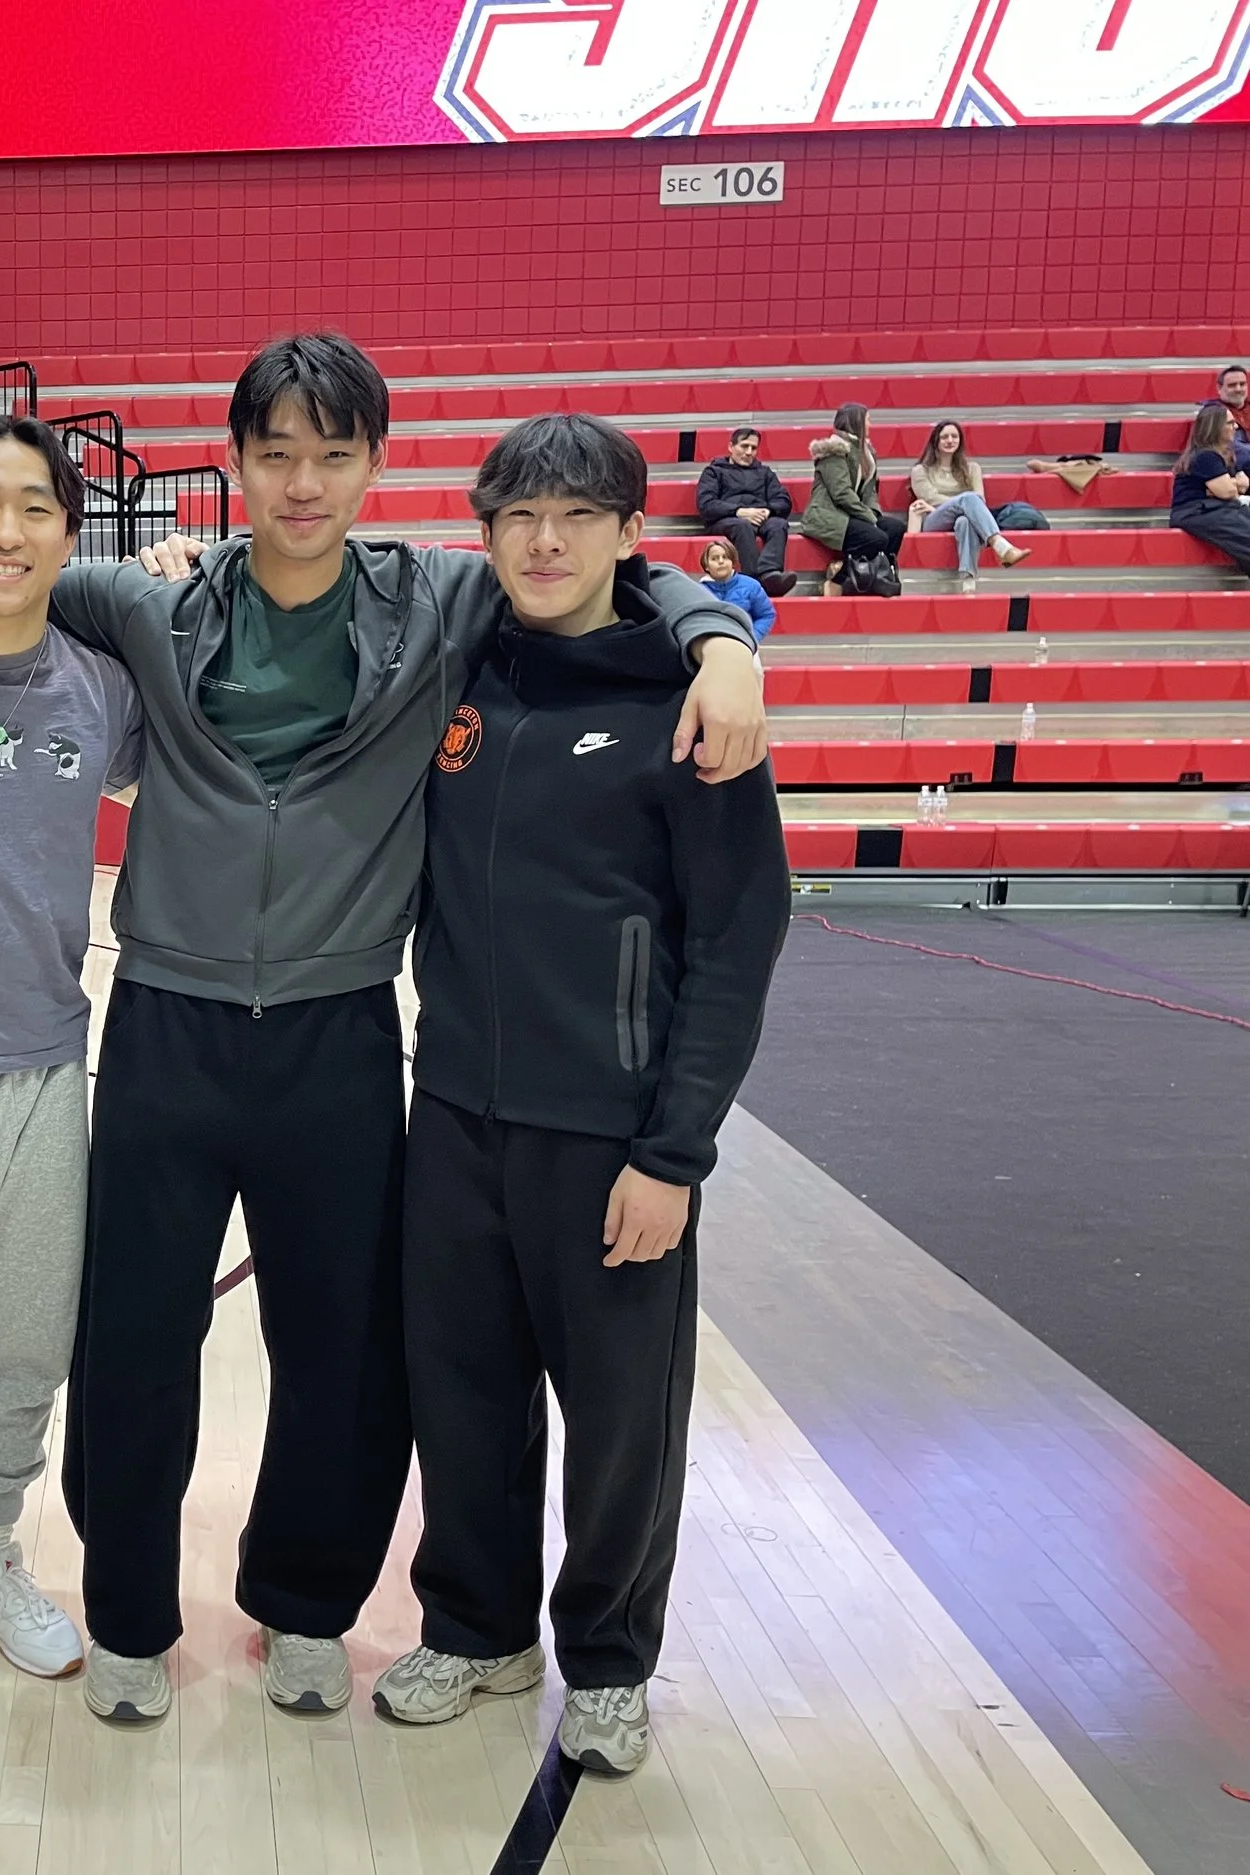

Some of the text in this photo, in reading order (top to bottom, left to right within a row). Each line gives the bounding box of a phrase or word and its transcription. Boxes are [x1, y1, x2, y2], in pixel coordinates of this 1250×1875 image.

[667, 166, 778, 197] SEC 106
[455, 707, 479, 731] INCETON
